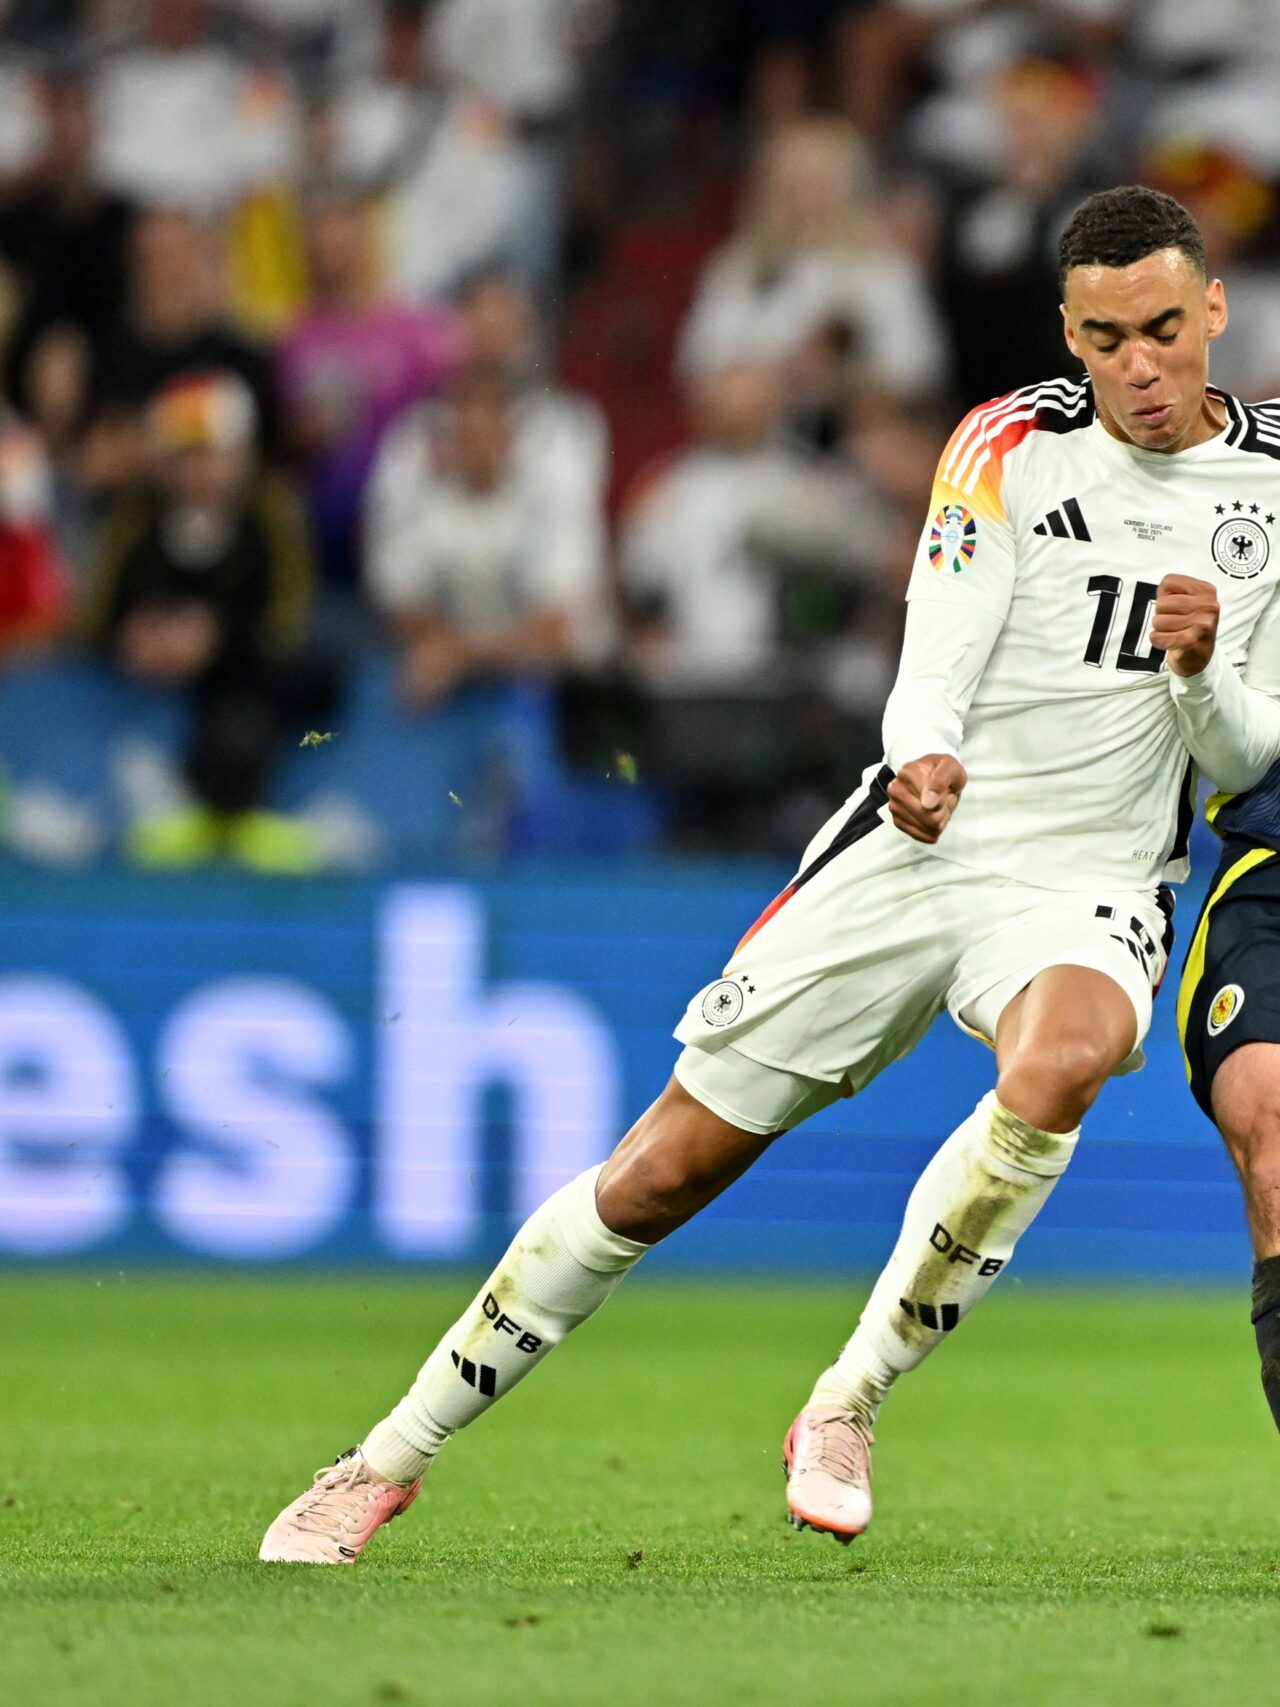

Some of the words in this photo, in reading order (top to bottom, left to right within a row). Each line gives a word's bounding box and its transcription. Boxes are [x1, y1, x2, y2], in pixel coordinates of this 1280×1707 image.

[1083, 574, 1169, 676] 10
[930, 1222, 1004, 1277] DFB
[482, 1291, 543, 1354] DFB
